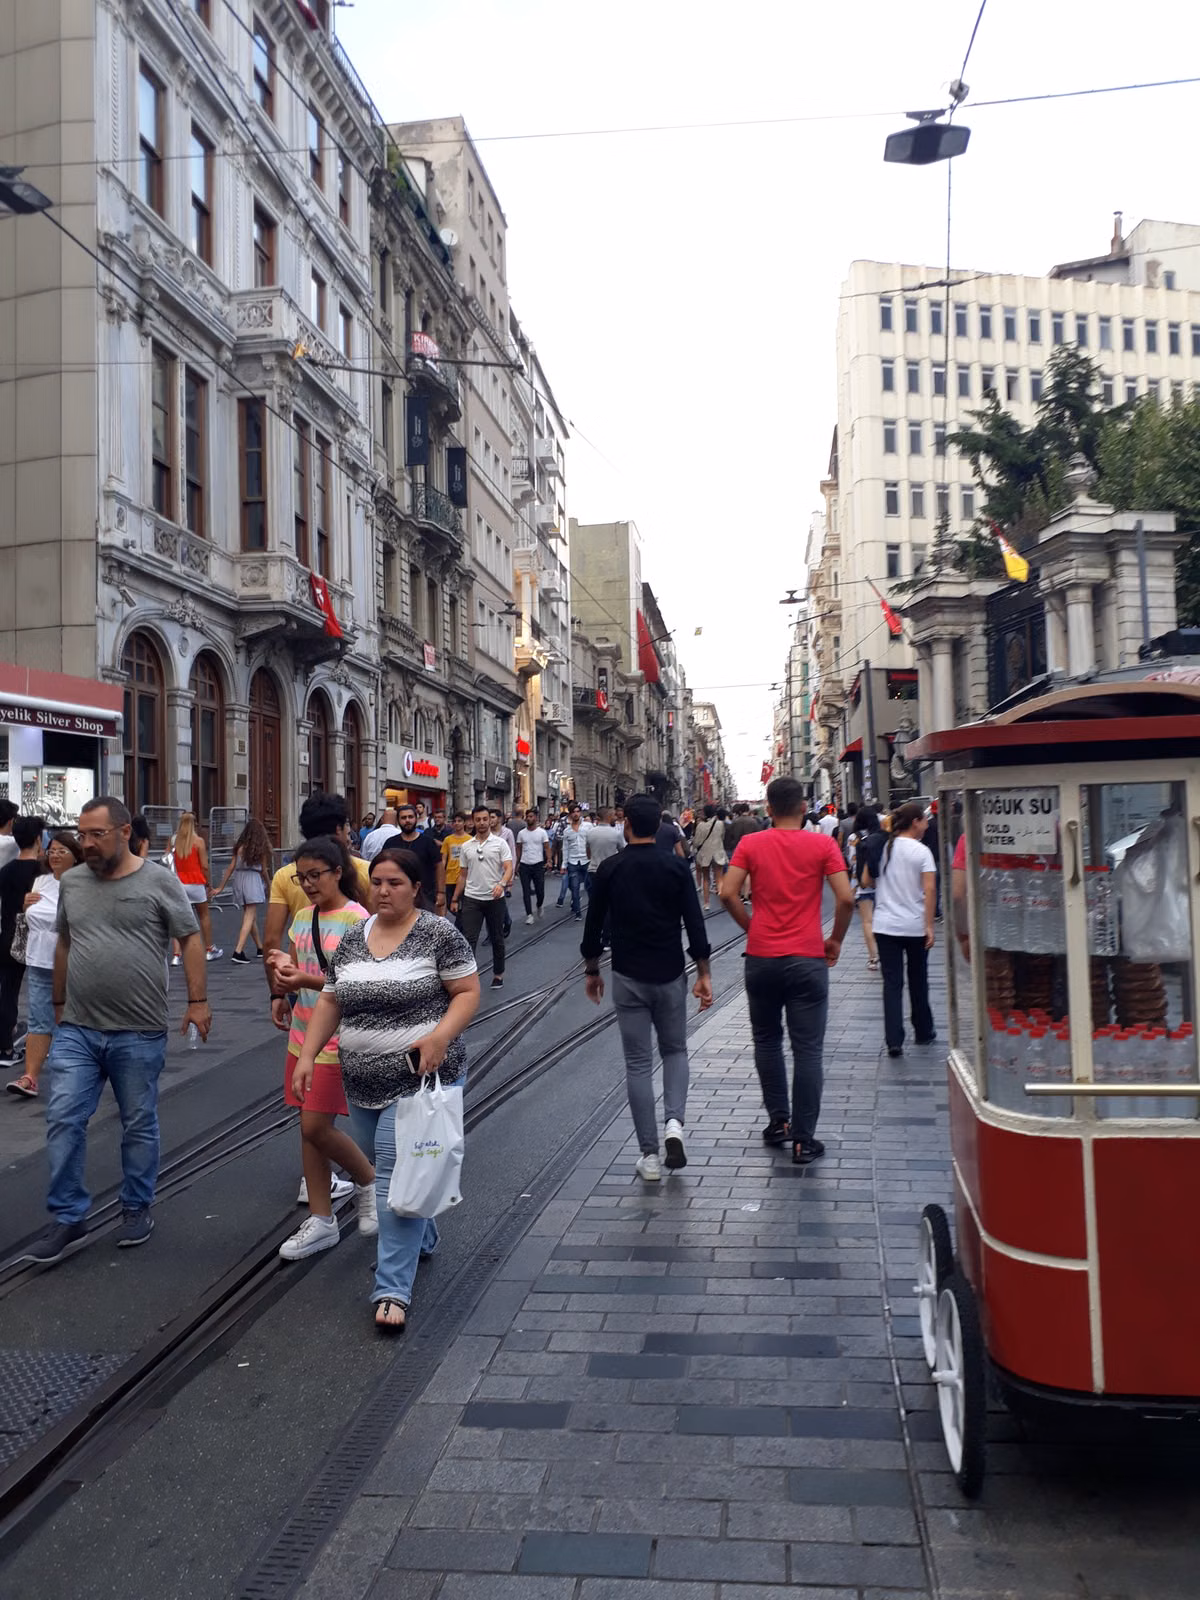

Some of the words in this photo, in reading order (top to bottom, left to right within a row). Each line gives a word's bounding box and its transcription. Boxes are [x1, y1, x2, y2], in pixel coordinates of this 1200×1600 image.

[36, 711, 71, 727] Silver
[74, 717, 104, 734] Shop
[1029, 798, 1052, 815] SU
[985, 824, 1010, 833] COLD
